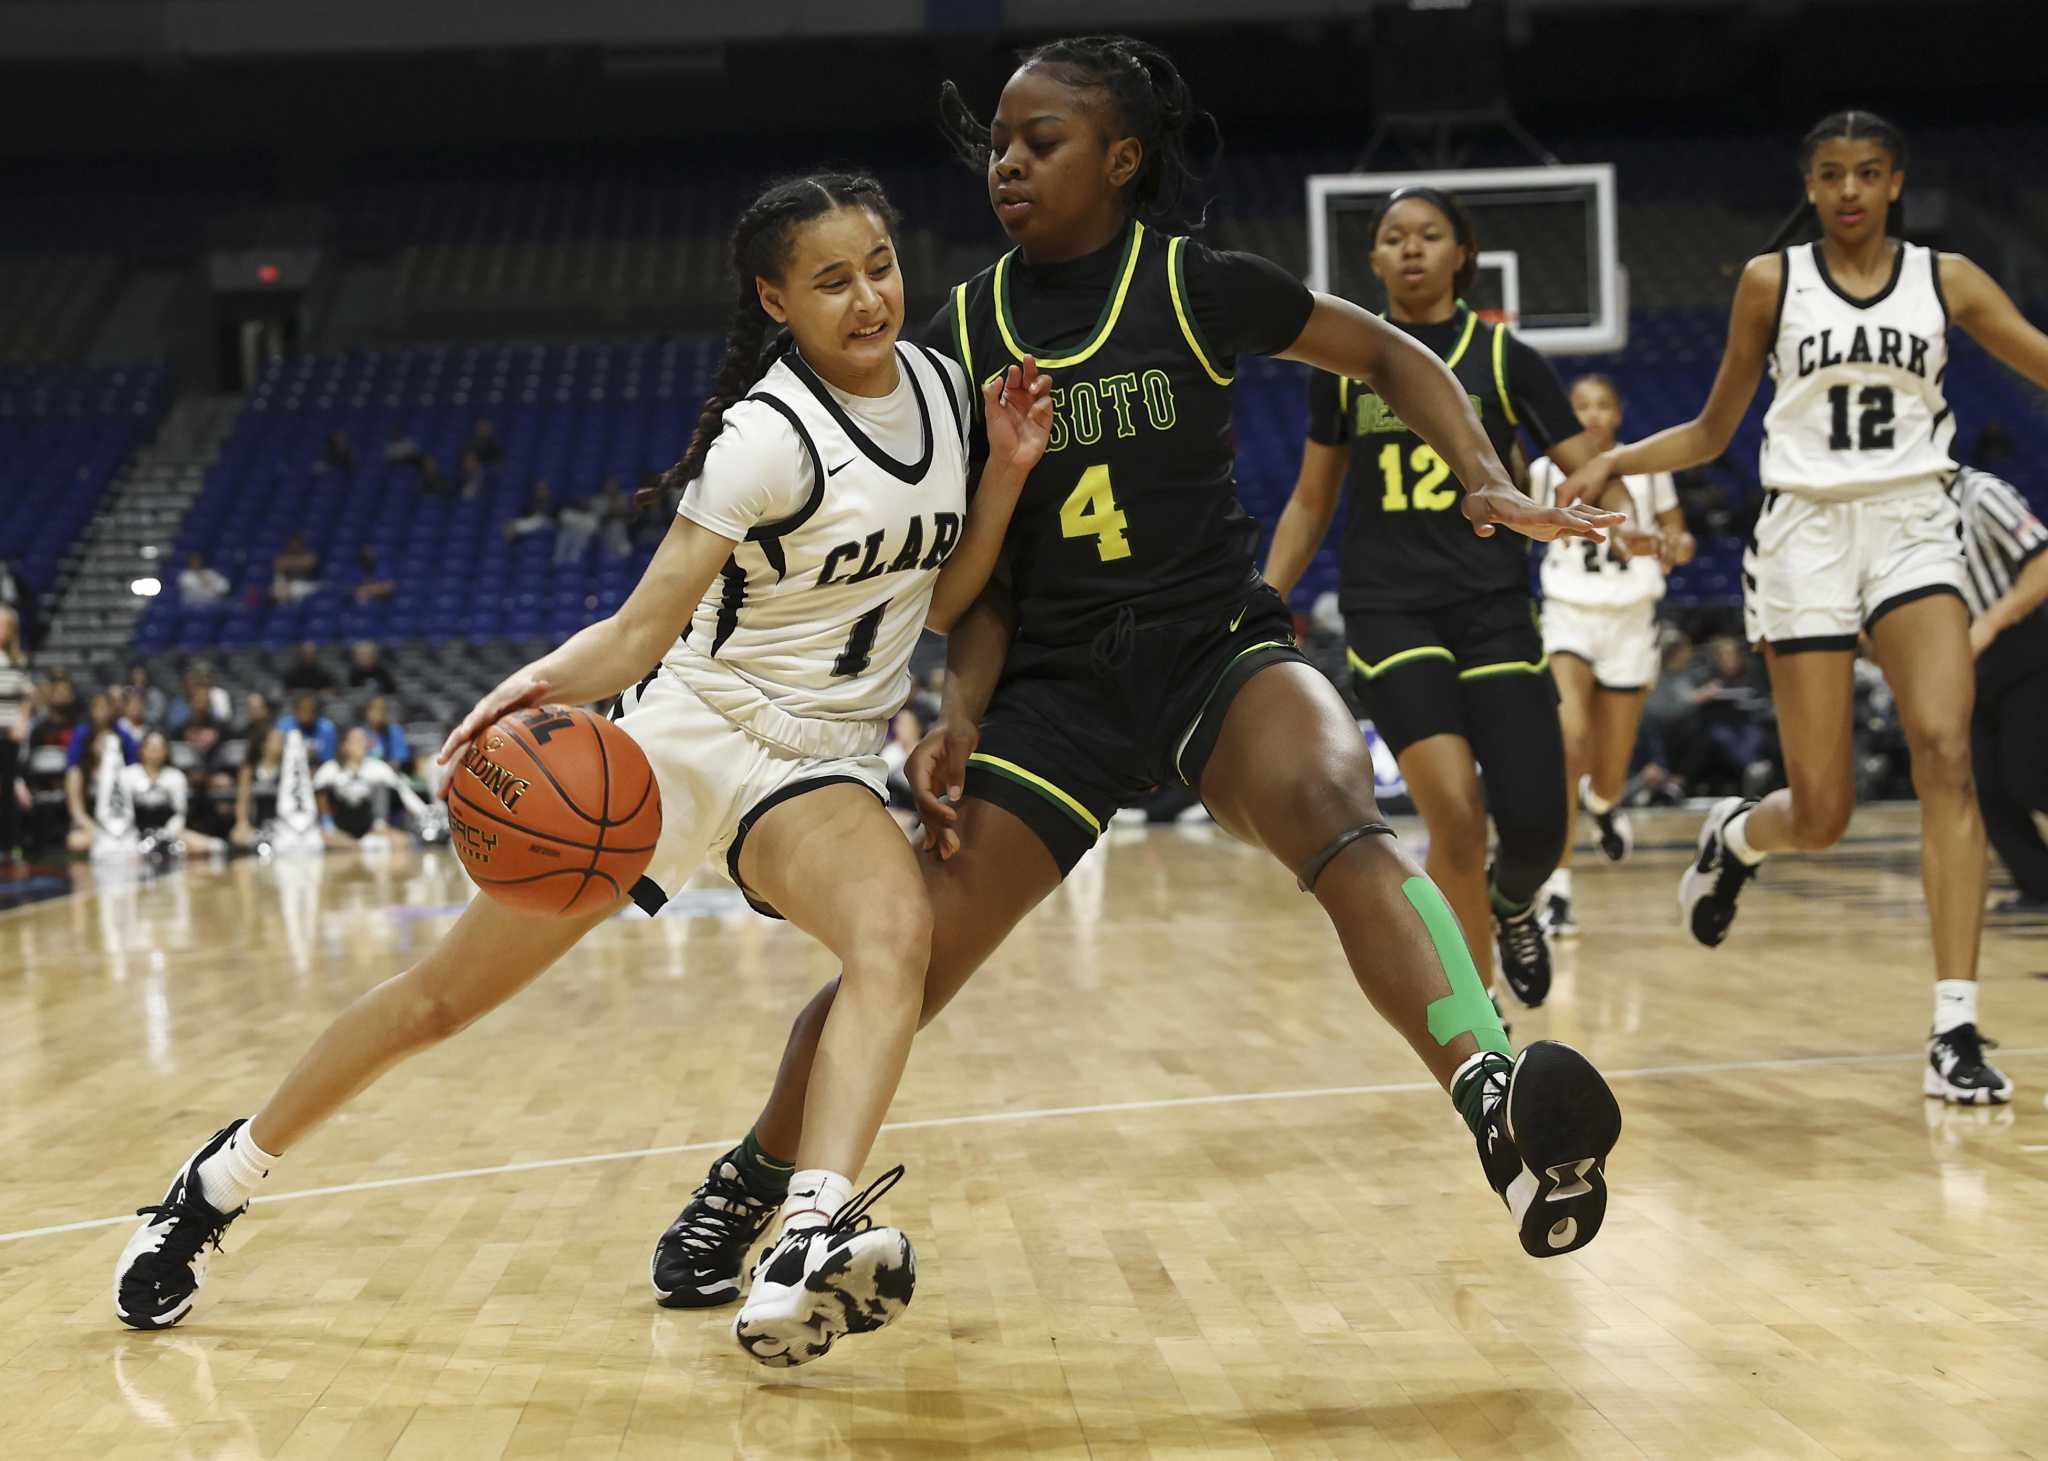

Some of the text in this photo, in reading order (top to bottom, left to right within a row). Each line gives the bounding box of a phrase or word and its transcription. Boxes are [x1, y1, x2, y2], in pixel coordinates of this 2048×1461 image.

[1798, 325, 1929, 378] CLARK
[1045, 369, 1176, 453] SOTO
[1827, 384, 1896, 451] 12
[1059, 463, 1132, 562] 4
[1378, 443, 1457, 511] 12
[815, 511, 966, 587] CLAR
[829, 597, 895, 678] 1
[462, 746, 531, 813] LDING
